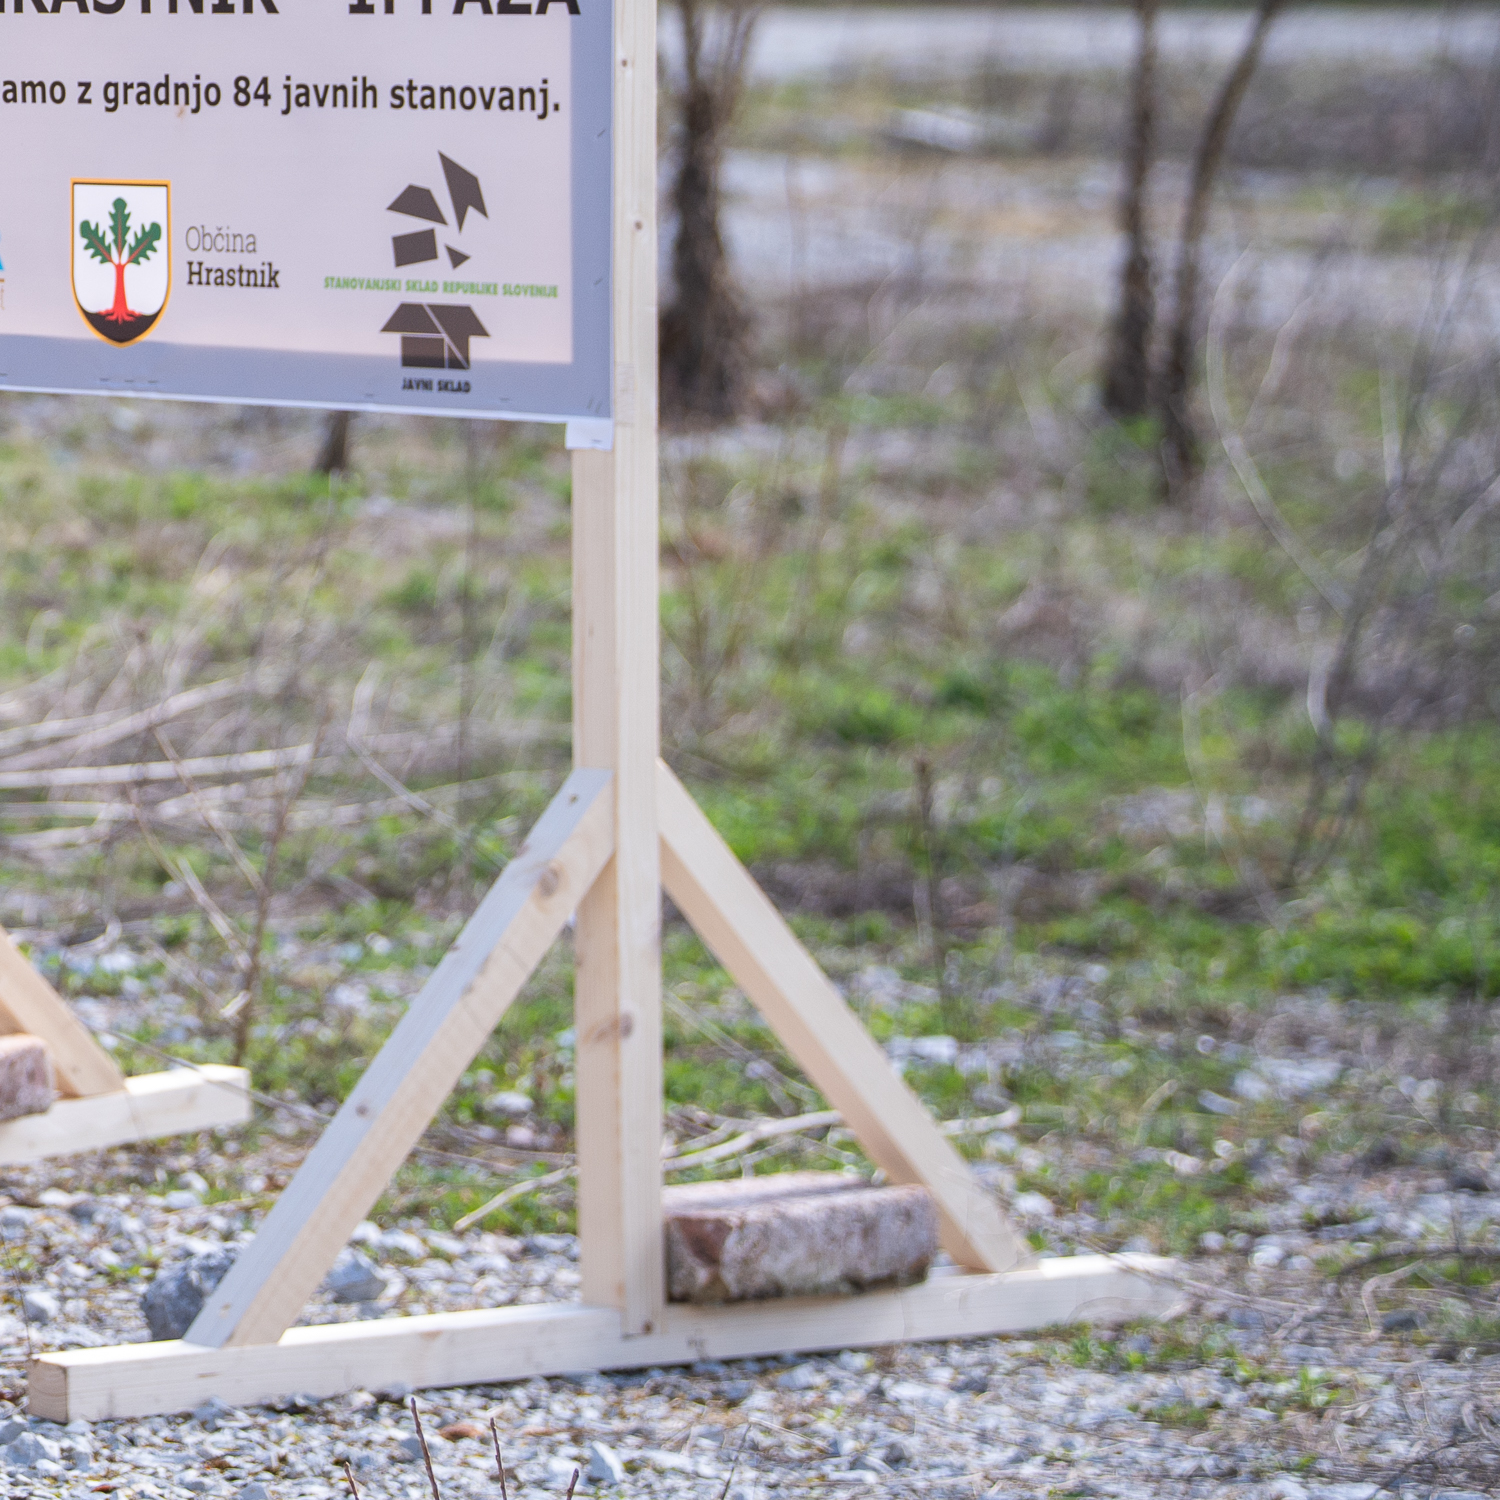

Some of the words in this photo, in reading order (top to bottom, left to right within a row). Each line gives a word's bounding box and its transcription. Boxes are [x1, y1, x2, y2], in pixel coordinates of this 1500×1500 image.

[77, 81, 93, 105] z
[102, 73, 222, 115] gradnjo
[233, 75, 272, 108] 84
[280, 74, 378, 116] javnih
[389, 78, 560, 121] stanovanj.
[185, 225, 257, 254] Občina
[186, 260, 281, 289] Hrastnik
[324, 276, 402, 292] STANOVANJSKI
[405, 279, 439, 294] SKLAD
[443, 280, 499, 296] REPUBLIKE
[502, 283, 559, 298] SLOVENIJE
[402, 378, 434, 392] JAVNI
[437, 379, 471, 393] SKLAD
